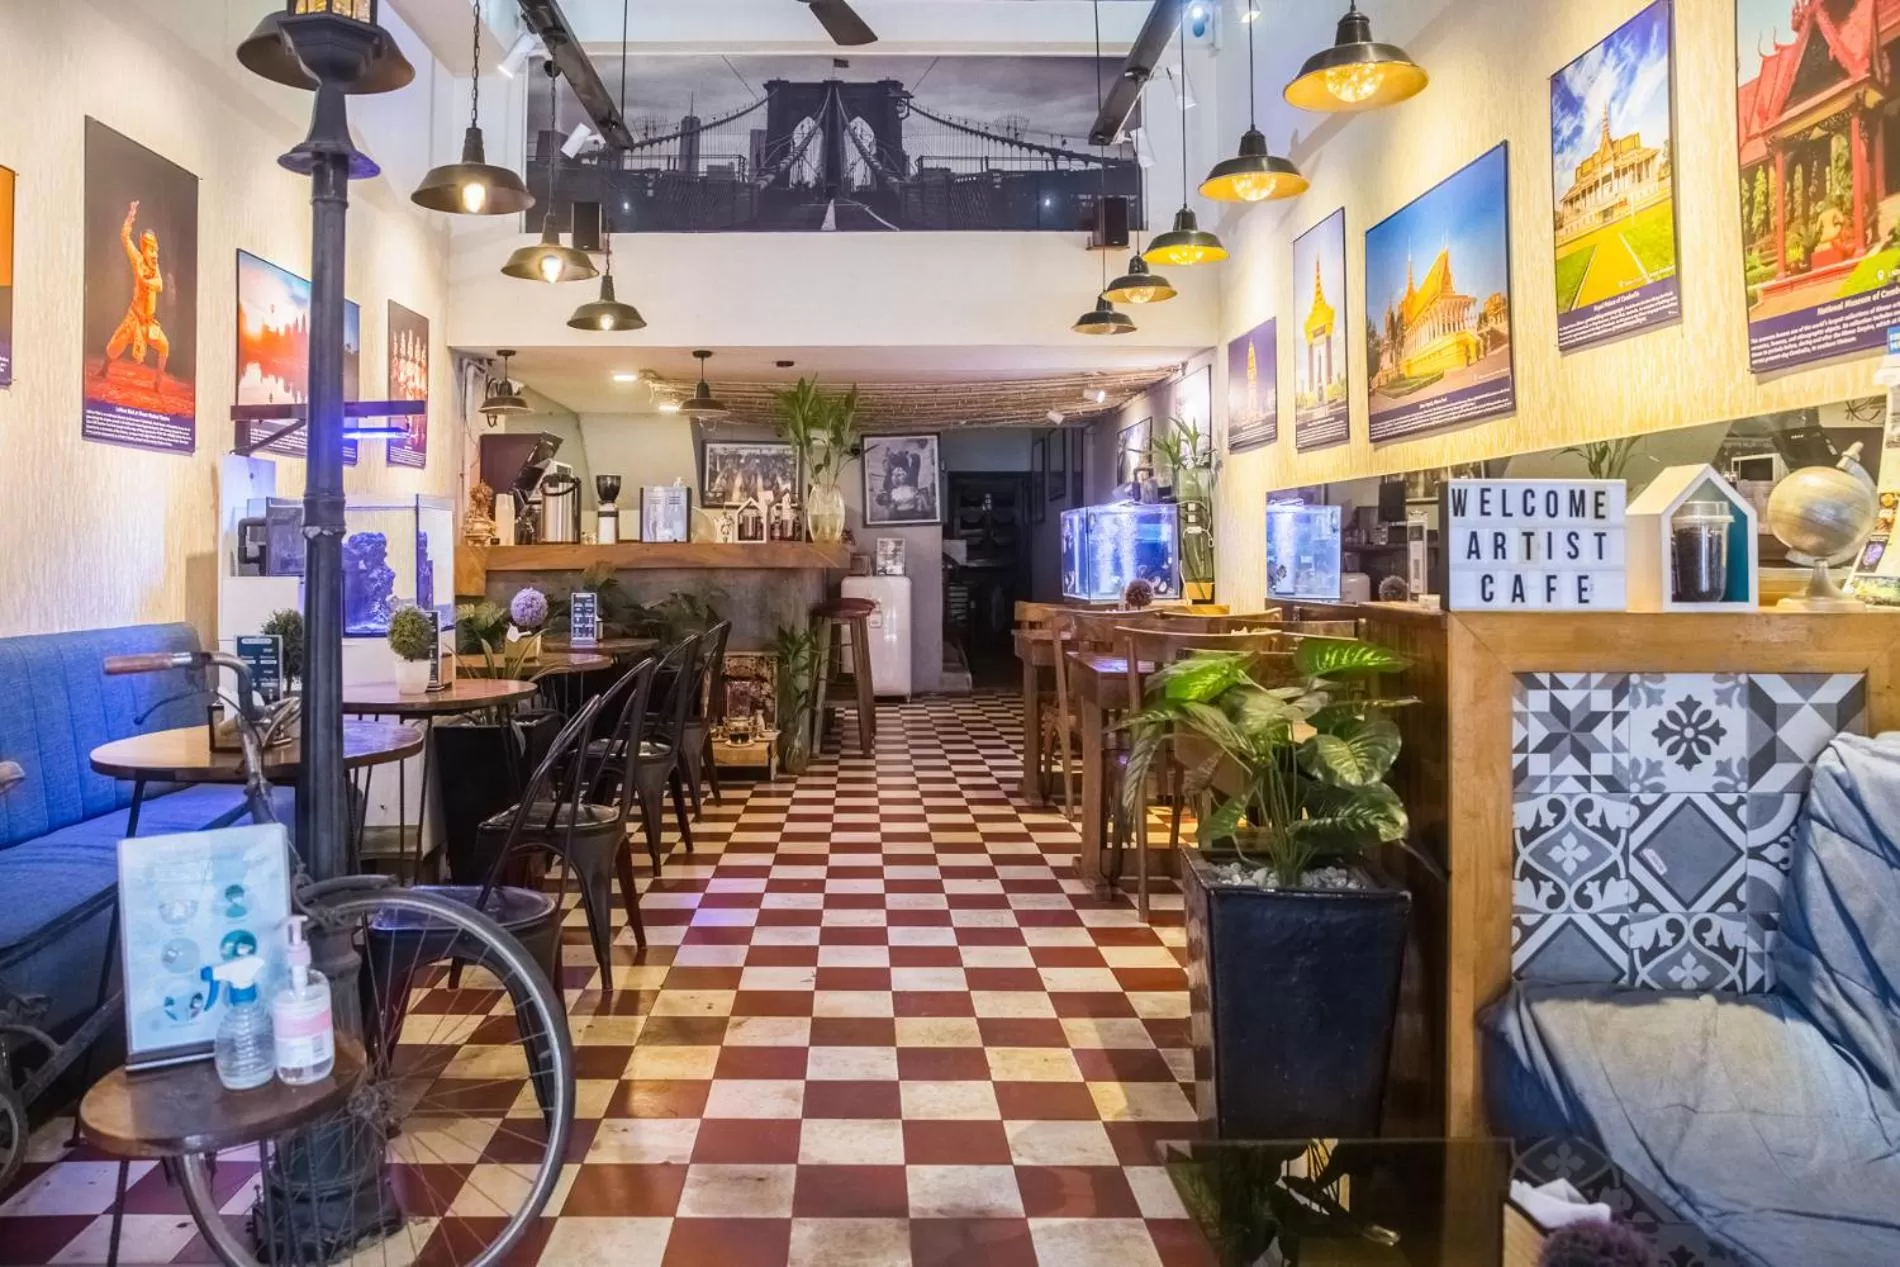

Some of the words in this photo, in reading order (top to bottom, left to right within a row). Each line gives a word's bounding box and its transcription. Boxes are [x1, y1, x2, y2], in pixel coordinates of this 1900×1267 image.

[1872, 290, 1880, 302] of
[1451, 487, 1606, 519] WELCOME
[1466, 531, 1607, 560] ARTIST
[1480, 574, 1590, 603] CAFE
